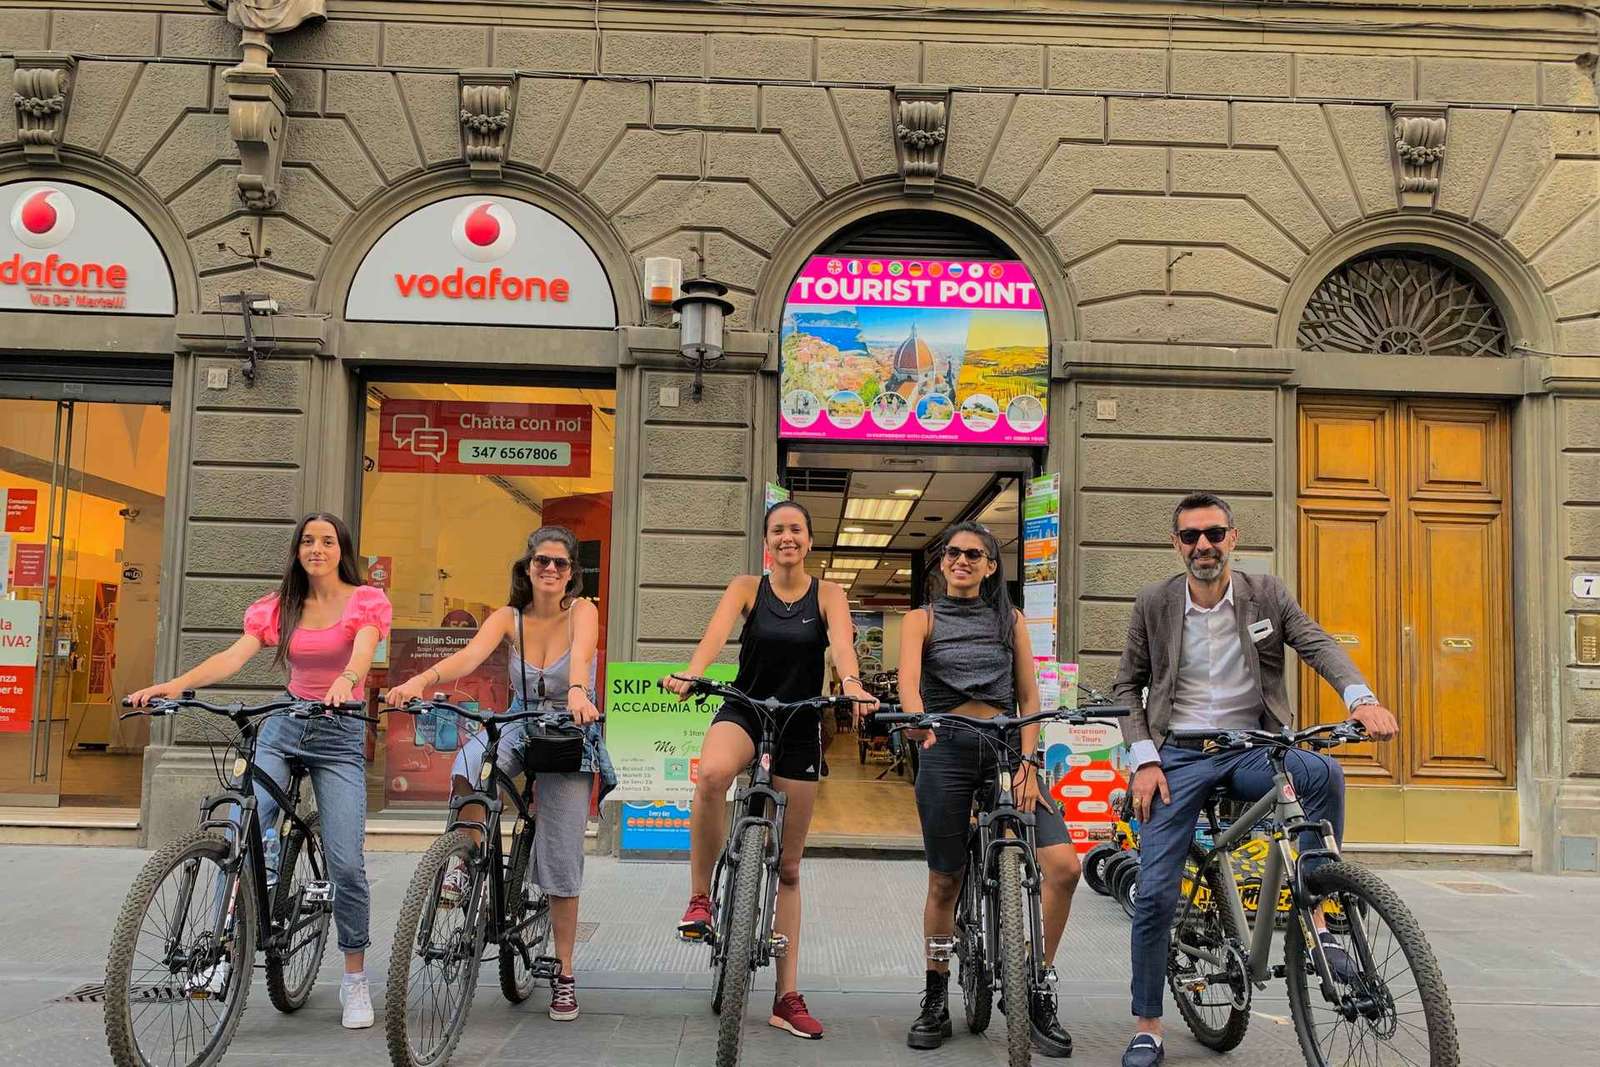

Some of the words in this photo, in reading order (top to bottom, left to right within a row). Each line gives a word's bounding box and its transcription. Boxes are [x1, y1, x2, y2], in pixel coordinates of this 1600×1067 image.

[394, 266, 571, 303] vodafone
[797, 276, 932, 302] TOURIST
[939, 280, 1036, 305] POINT
[459, 413, 516, 430] Chatta
[520, 417, 551, 431] con
[555, 416, 582, 433] noi
[471, 446, 496, 459] 347
[499, 447, 558, 461] 6567806
[1583, 578, 1594, 596] 7
[2, 635, 32, 648] IVA?
[416, 635, 445, 645] Italian
[613, 679, 652, 694] SKIP
[612, 702, 691, 713] ACCADEMIA
[1069, 727, 1107, 735] Excursions
[1082, 735, 1101, 743] Tours
[653, 740, 677, 756] My
